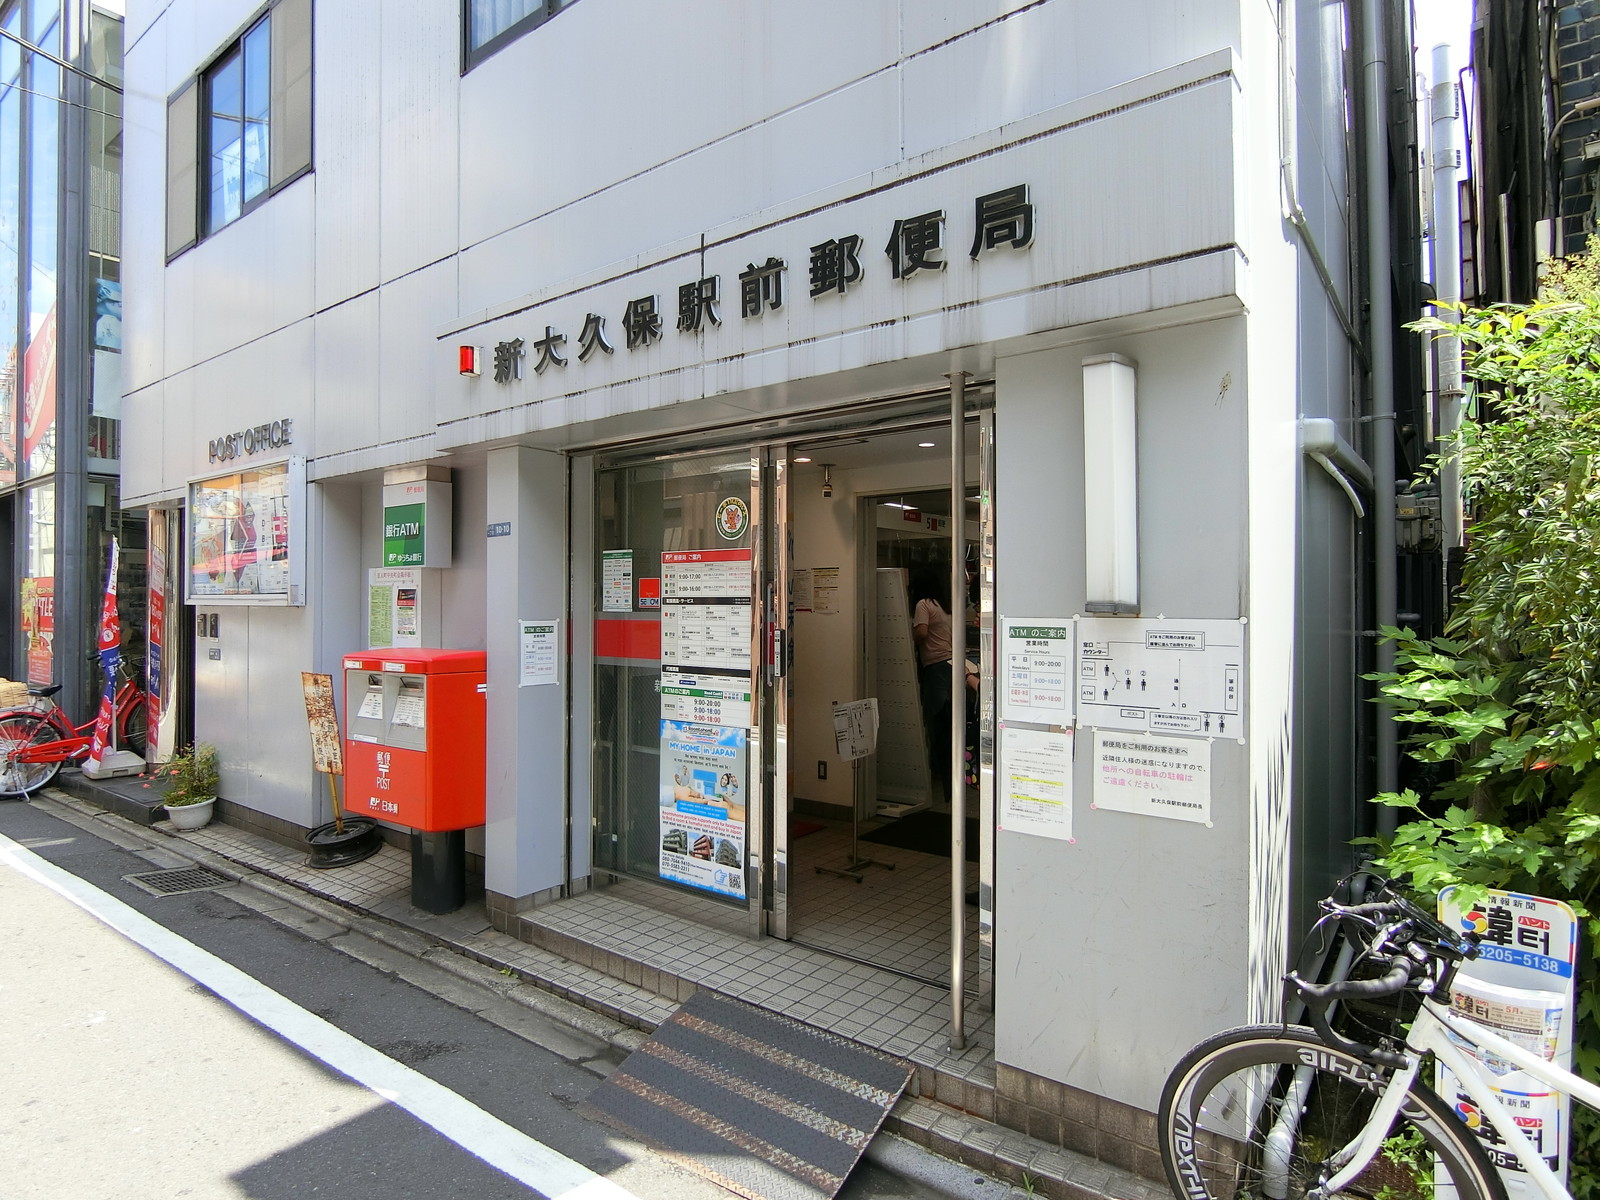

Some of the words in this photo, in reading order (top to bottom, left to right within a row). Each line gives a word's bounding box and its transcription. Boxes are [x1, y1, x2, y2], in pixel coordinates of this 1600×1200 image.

[493, 183, 1036, 384] 新大久保駅前郵便局
[208, 431, 243, 464] POST
[244, 418, 293, 456] OFFICE
[385, 521, 420, 538] 銀行ATM
[397, 552, 423, 563] ゆうちょ銀行
[639, 598, 660, 606] SECOM
[1031, 629, 1066, 638] のご案内
[1034, 660, 1062, 668] 9:00-20:00
[694, 698, 721, 708] 9:00-20:00
[694, 706, 721, 715] 9:00-18:00
[694, 714, 721, 723] 9:00-18:00
[680, 743, 702, 753] HOME
[703, 747, 710, 755] in
[711, 748, 736, 758] JAPAN
[1102, 740, 1188, 755] 郵便局をご利用のお客さまへ
[1102, 764, 1193, 782] 他所への自転車の駐輪は
[376, 776, 391, 791] POST
[1102, 776, 1163, 791] ご遠慮ください。
